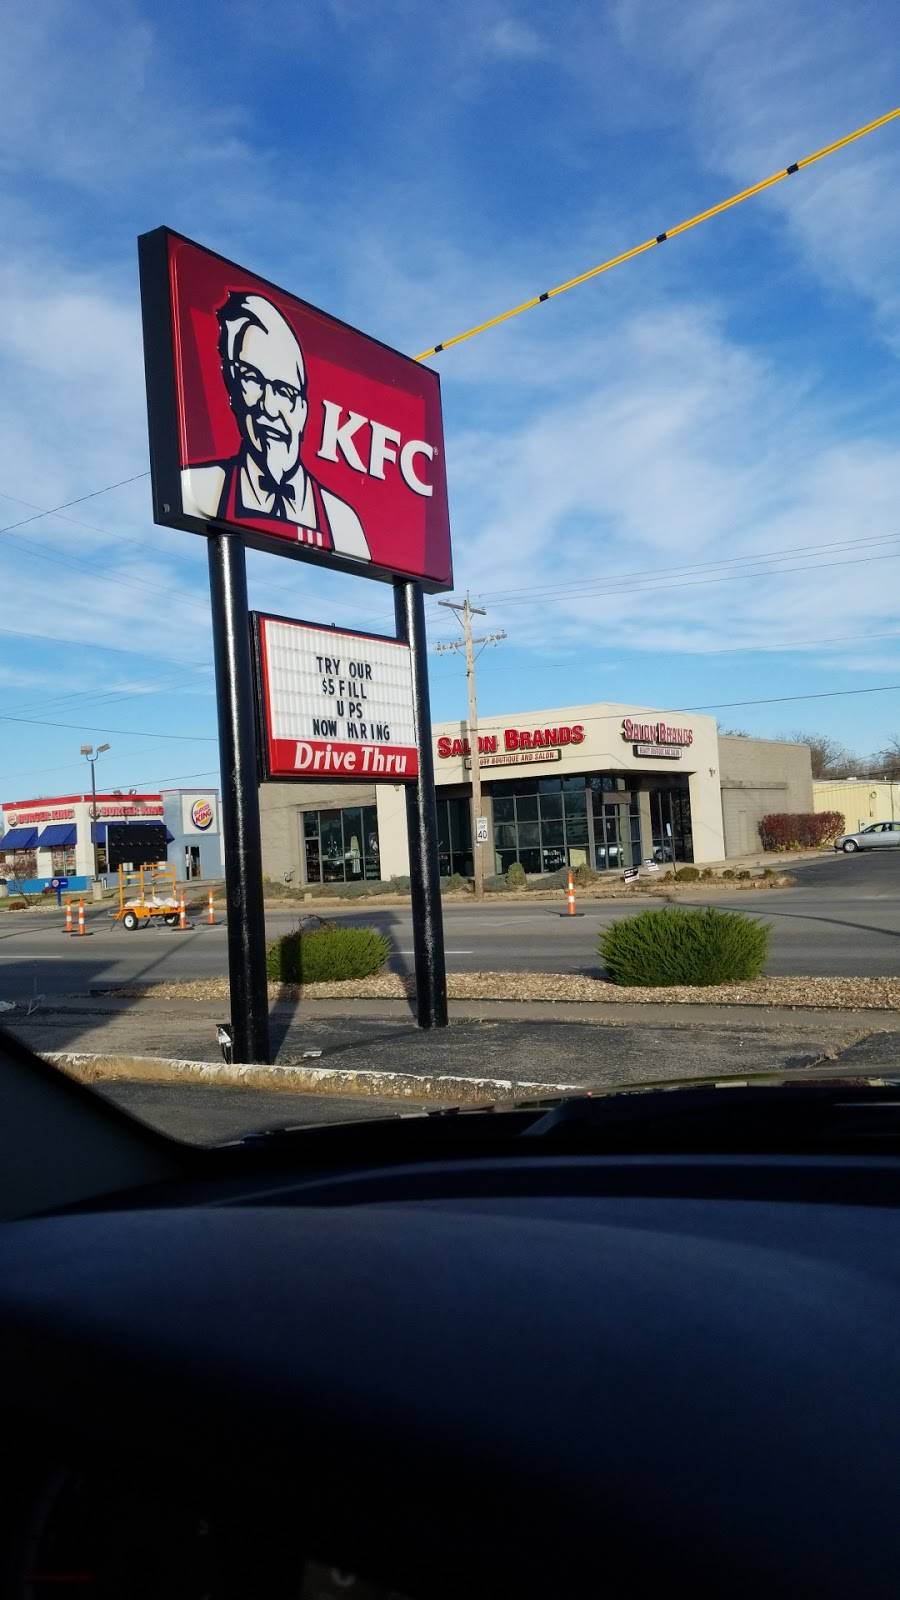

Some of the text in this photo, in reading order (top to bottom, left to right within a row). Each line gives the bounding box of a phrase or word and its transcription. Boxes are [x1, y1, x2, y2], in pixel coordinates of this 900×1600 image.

[317, 399, 433, 497] KFC
[316, 656, 372, 680] TRY OUR
[322, 678, 367, 699] $5 FILL
[313, 719, 390, 740] NOW HIRING
[504, 725, 585, 751] BRANDS
[624, 718, 693, 744] SALON BRANDS
[294, 742, 407, 773] Drive Thru
[491, 754, 519, 765] BOUTIQUE
[521, 753, 533, 761] AND
[534, 751, 555, 761] SALON
[195, 809, 213, 823] KING
[477, 830, 487, 839] 40
